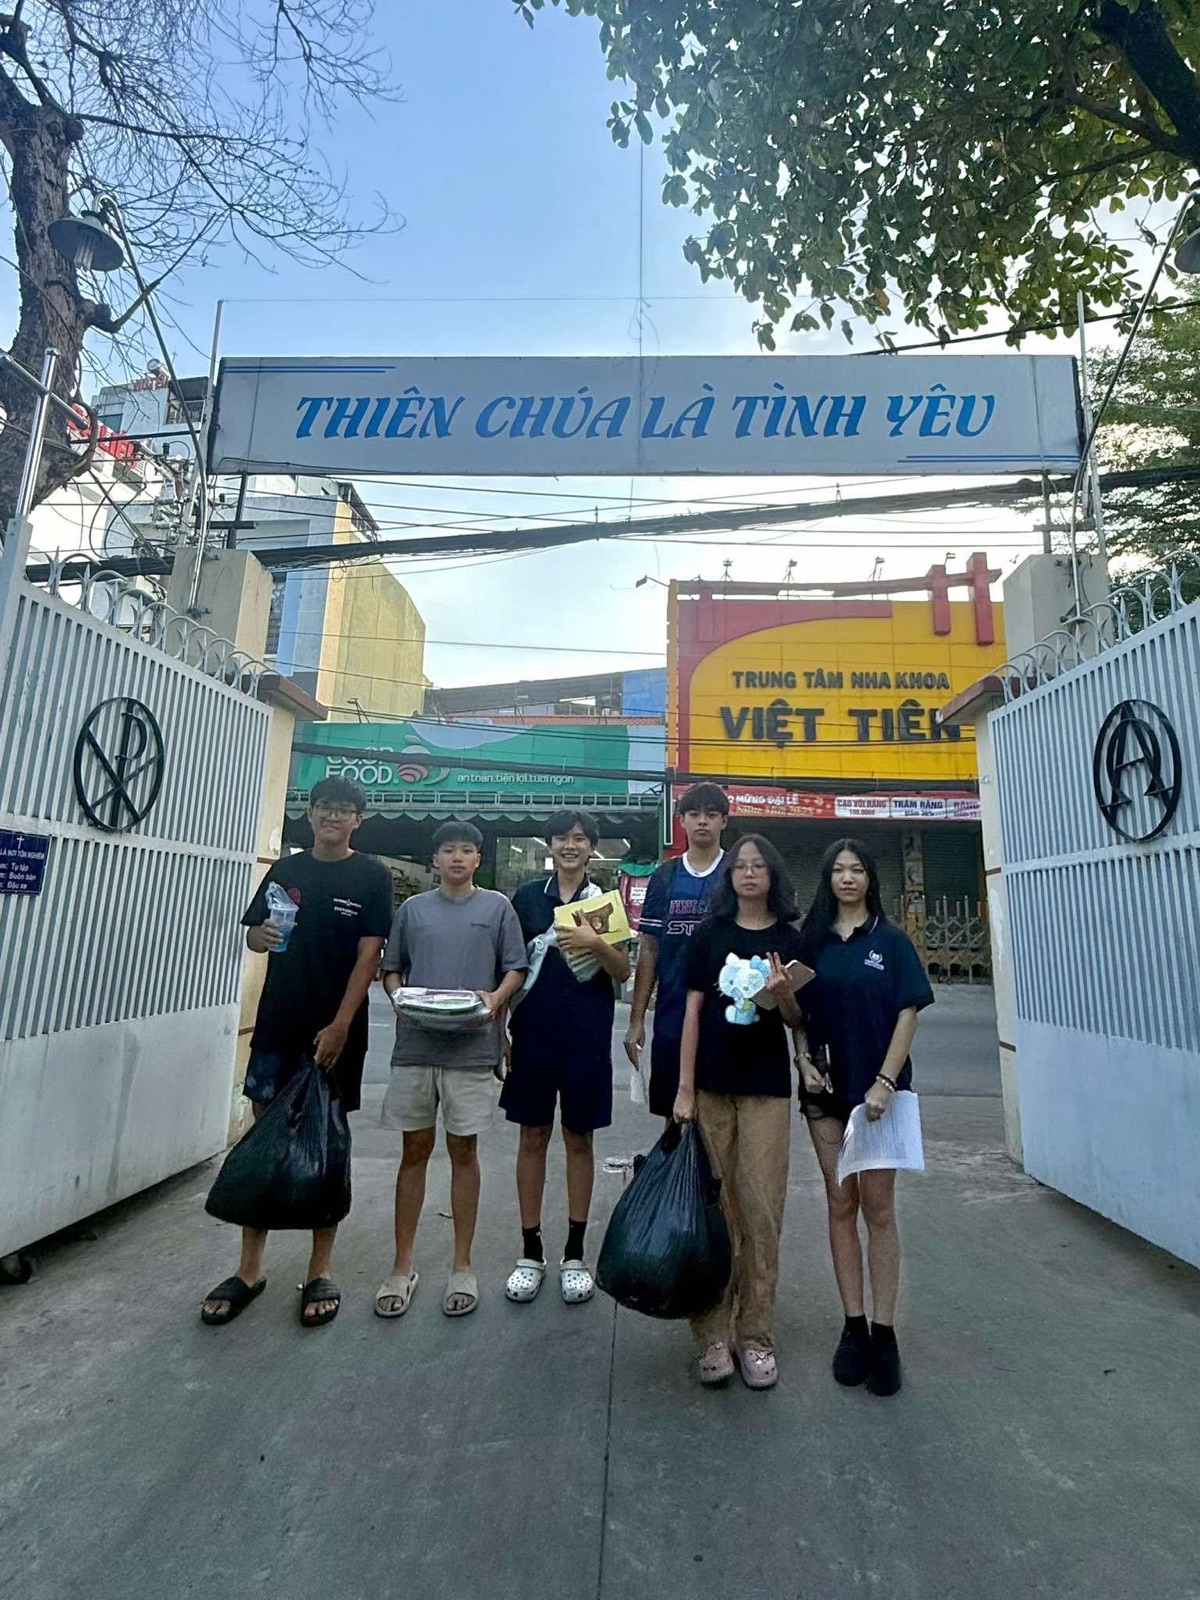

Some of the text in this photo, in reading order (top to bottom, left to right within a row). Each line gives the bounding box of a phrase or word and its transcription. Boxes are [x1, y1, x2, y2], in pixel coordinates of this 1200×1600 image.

[296, 382, 995, 439] THIÊN CHÚA LÀ TÌNH YÊU
[732, 668, 950, 690] TRUNG TÂM NHA KHOA
[720, 698, 824, 748] VIỆT
